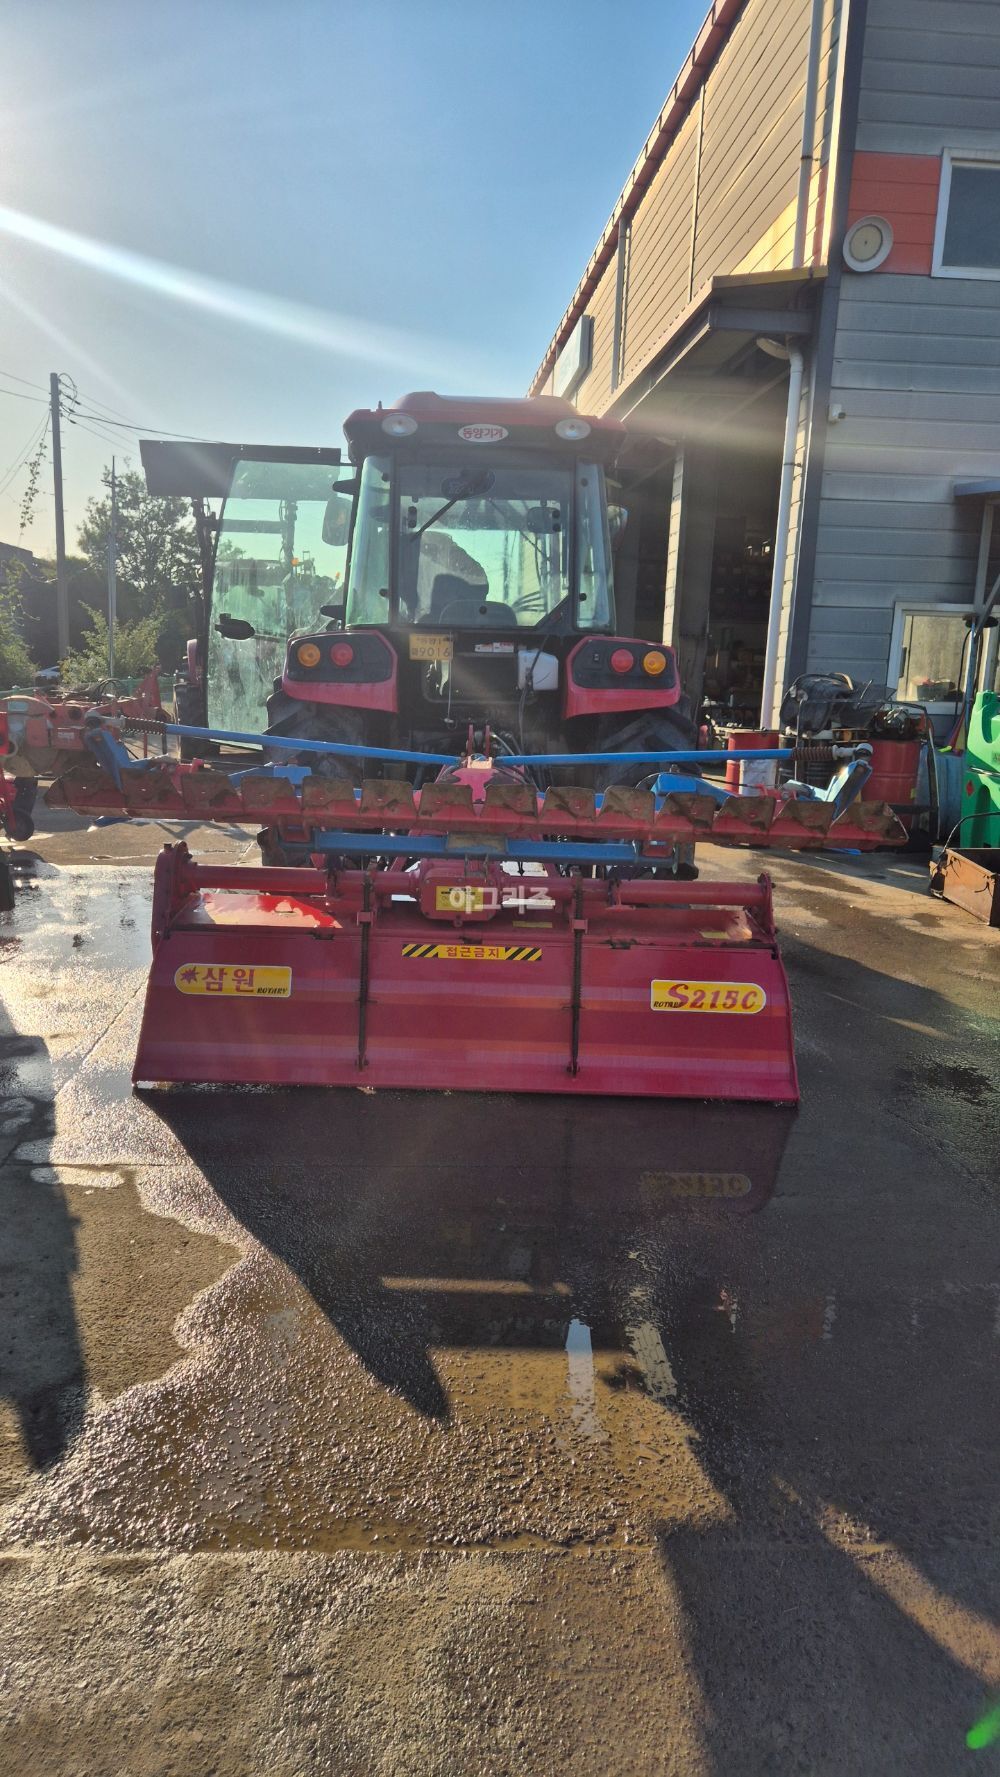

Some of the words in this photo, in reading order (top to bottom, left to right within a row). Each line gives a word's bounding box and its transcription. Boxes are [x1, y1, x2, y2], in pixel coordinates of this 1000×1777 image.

[463, 427, 503, 439] 동양기계
[446, 946, 500, 959] 접근금지
[202, 967, 255, 993] 삼원
[667, 983, 758, 1010] S215C
